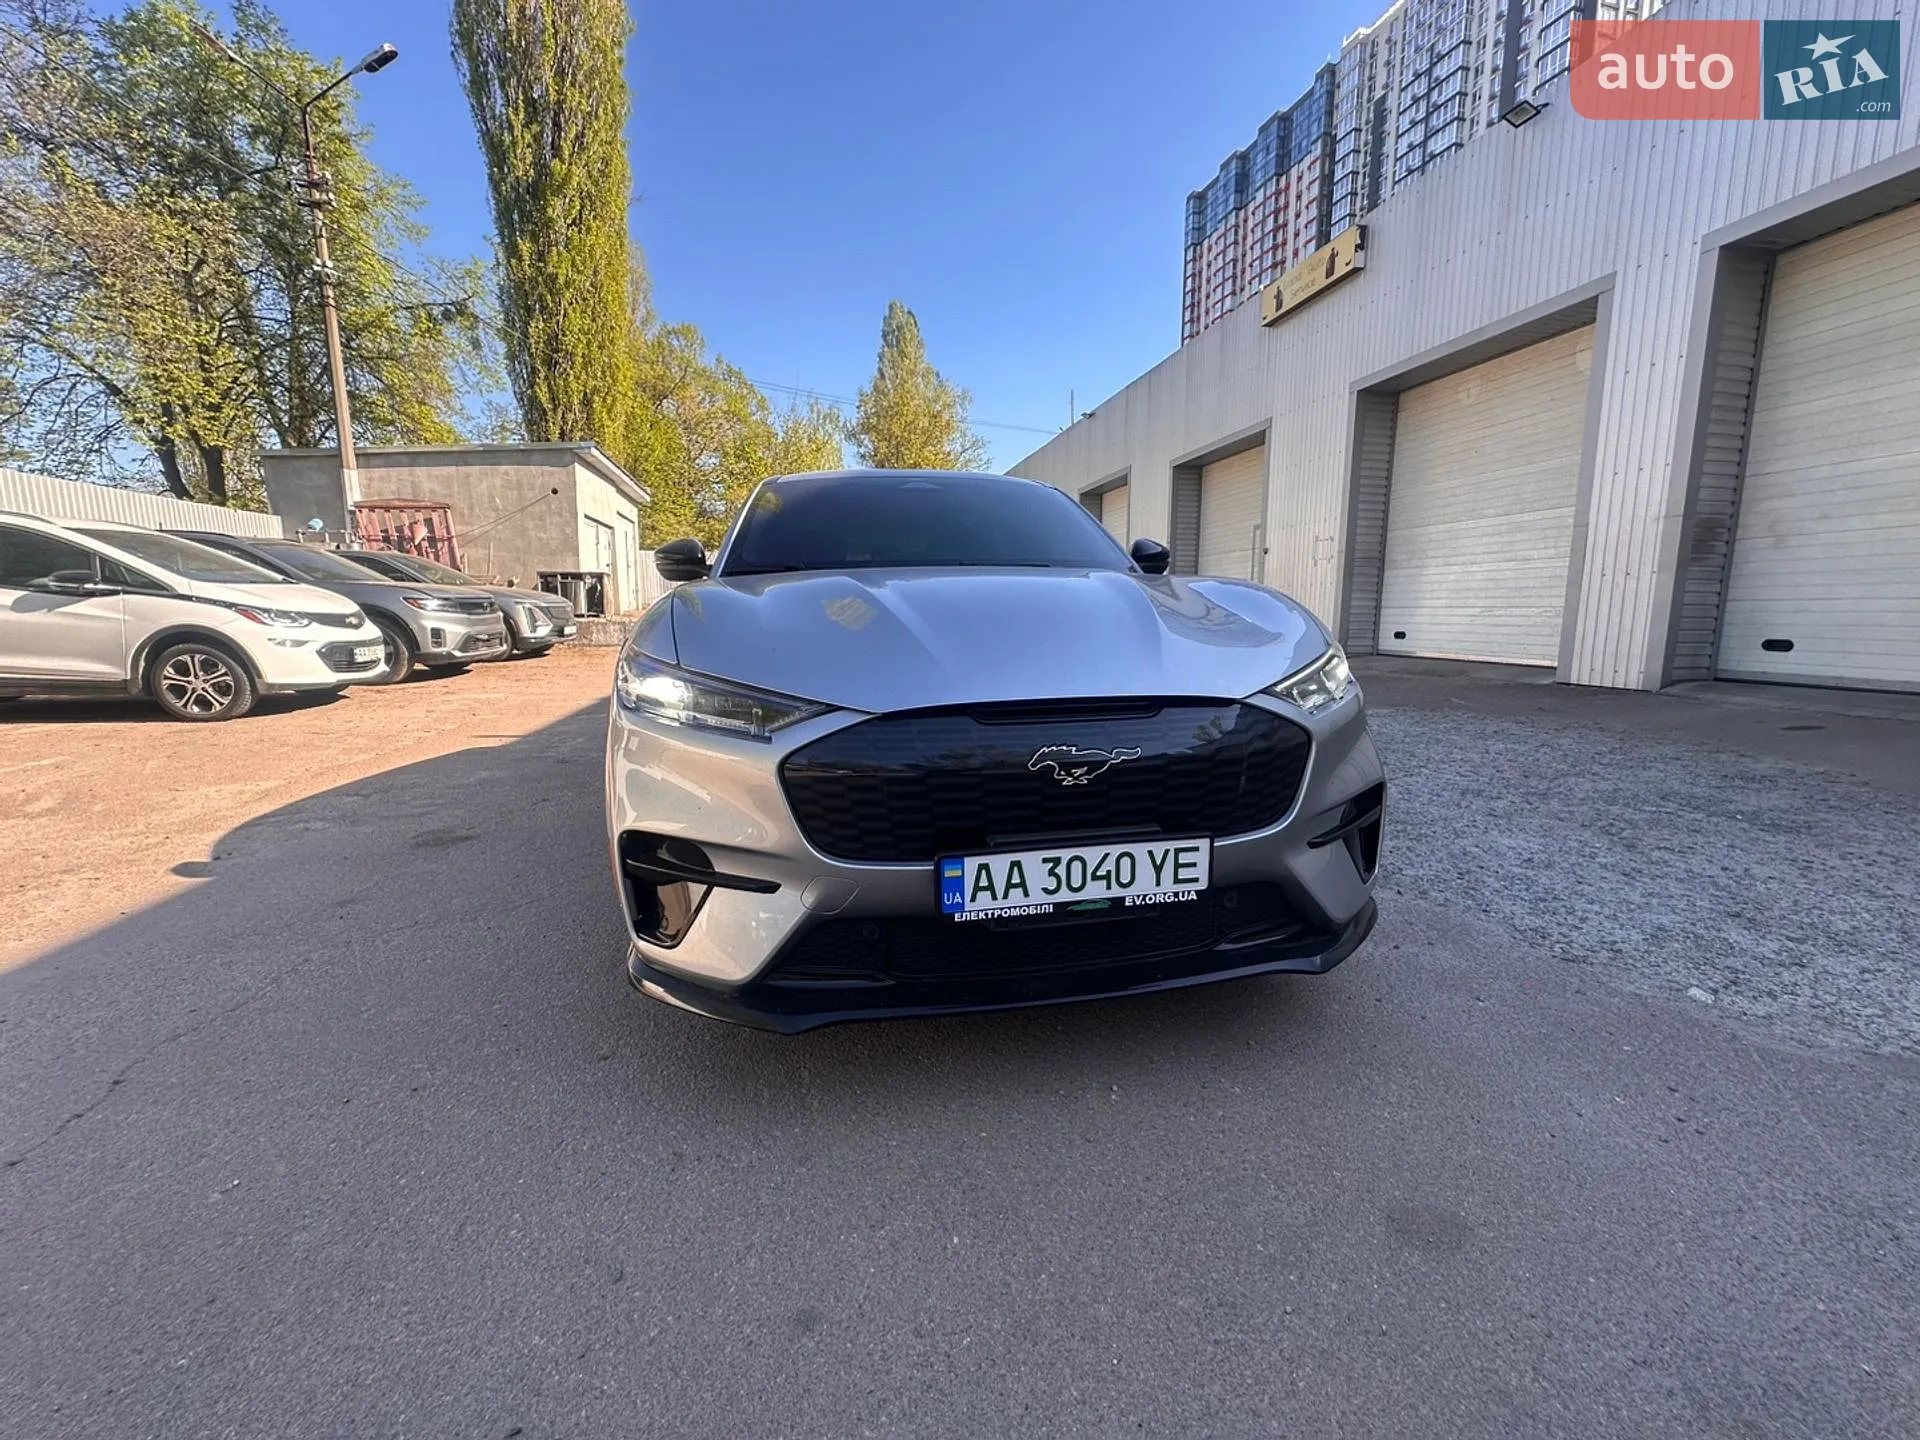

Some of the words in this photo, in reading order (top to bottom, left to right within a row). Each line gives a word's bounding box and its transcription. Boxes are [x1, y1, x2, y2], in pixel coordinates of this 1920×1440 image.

[969, 860, 1030, 902] AA
[1041, 851, 1136, 894] 3040
[1147, 846, 1200, 886] YE
[944, 892, 963, 905] UA
[1124, 890, 1198, 906] EV.ORG.UA
[954, 904, 1054, 922] ЕЛЕКТРОМОБІЛІ
